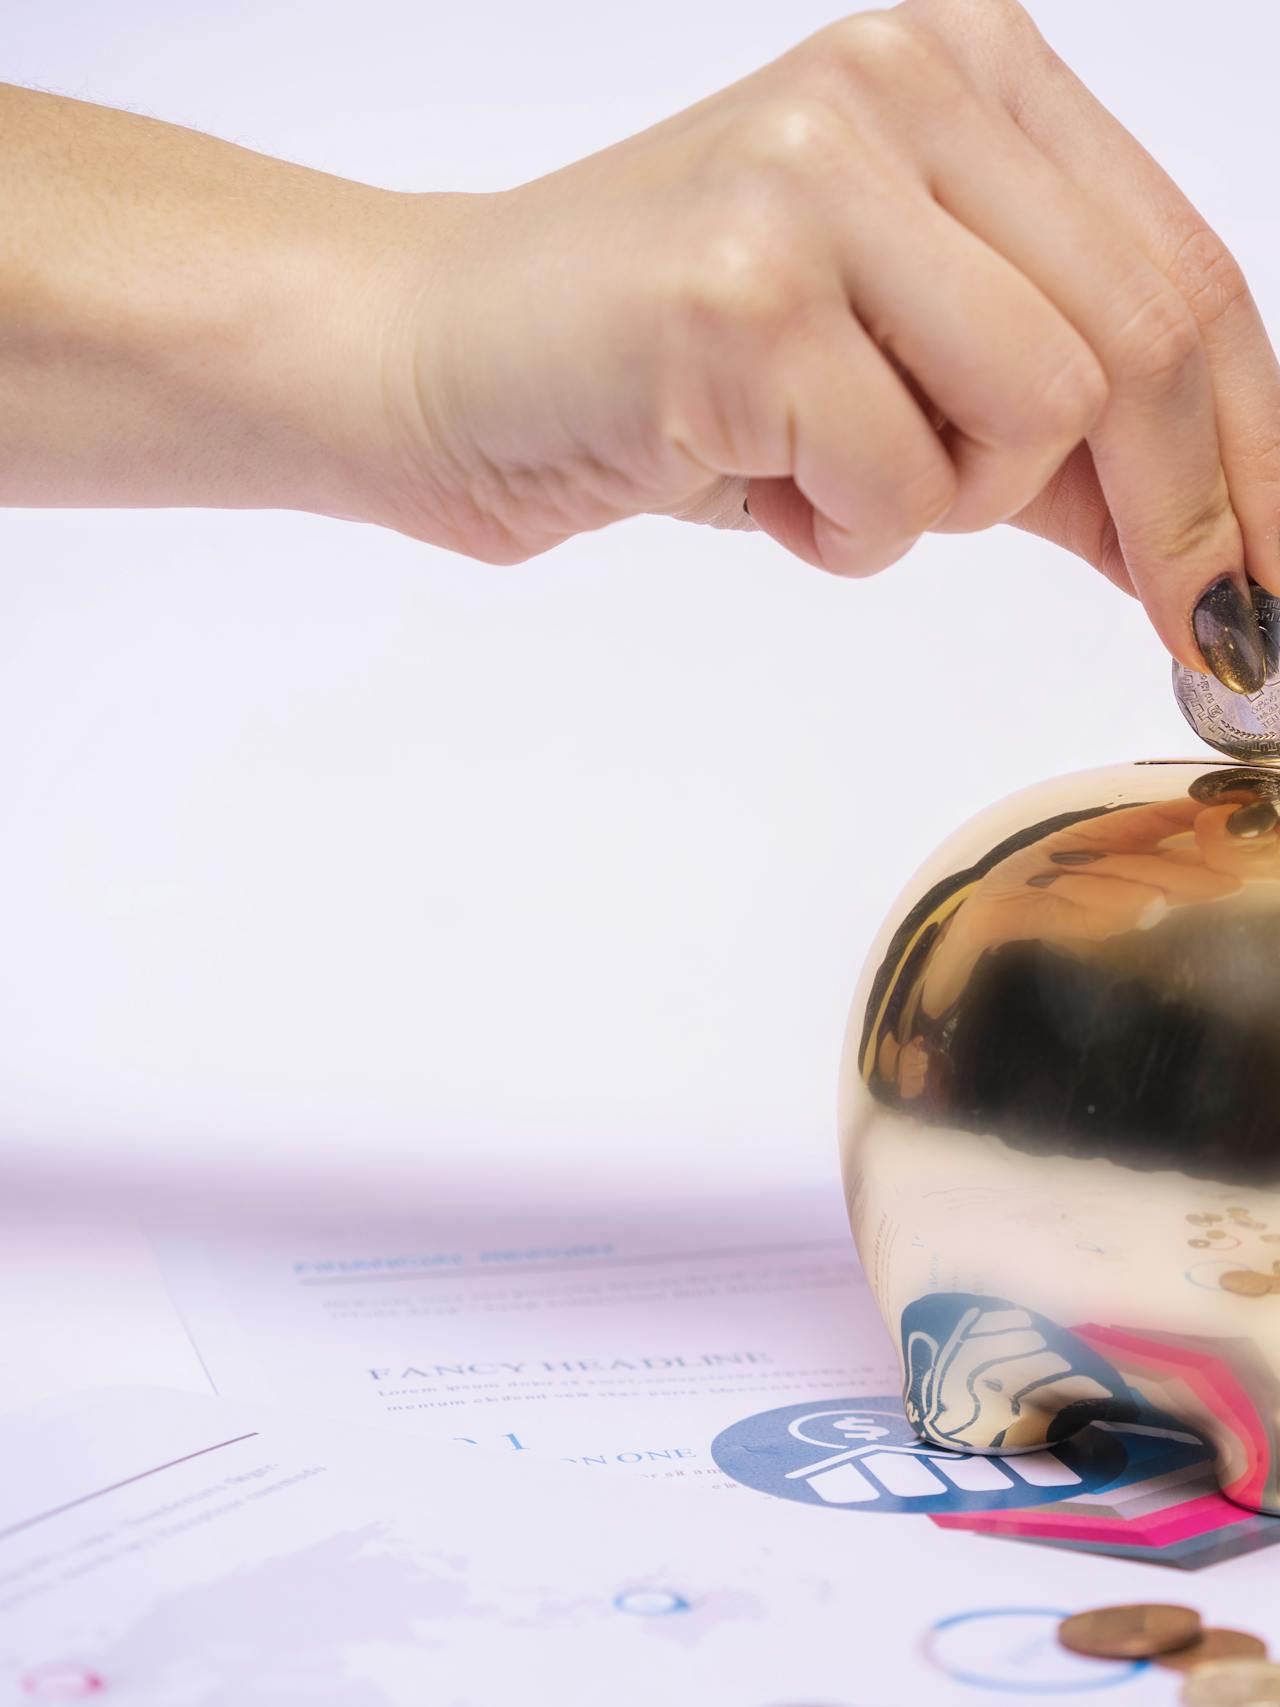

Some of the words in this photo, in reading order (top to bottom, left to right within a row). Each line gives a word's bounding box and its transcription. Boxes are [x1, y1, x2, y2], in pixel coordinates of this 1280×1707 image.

[368, 1361, 525, 1381] FANCY
[542, 1352, 774, 1374] HEADLINE
[378, 1387, 438, 1398] Lorem
[446, 1382, 500, 1393] ipsum
[615, 1447, 698, 1464] ONE
